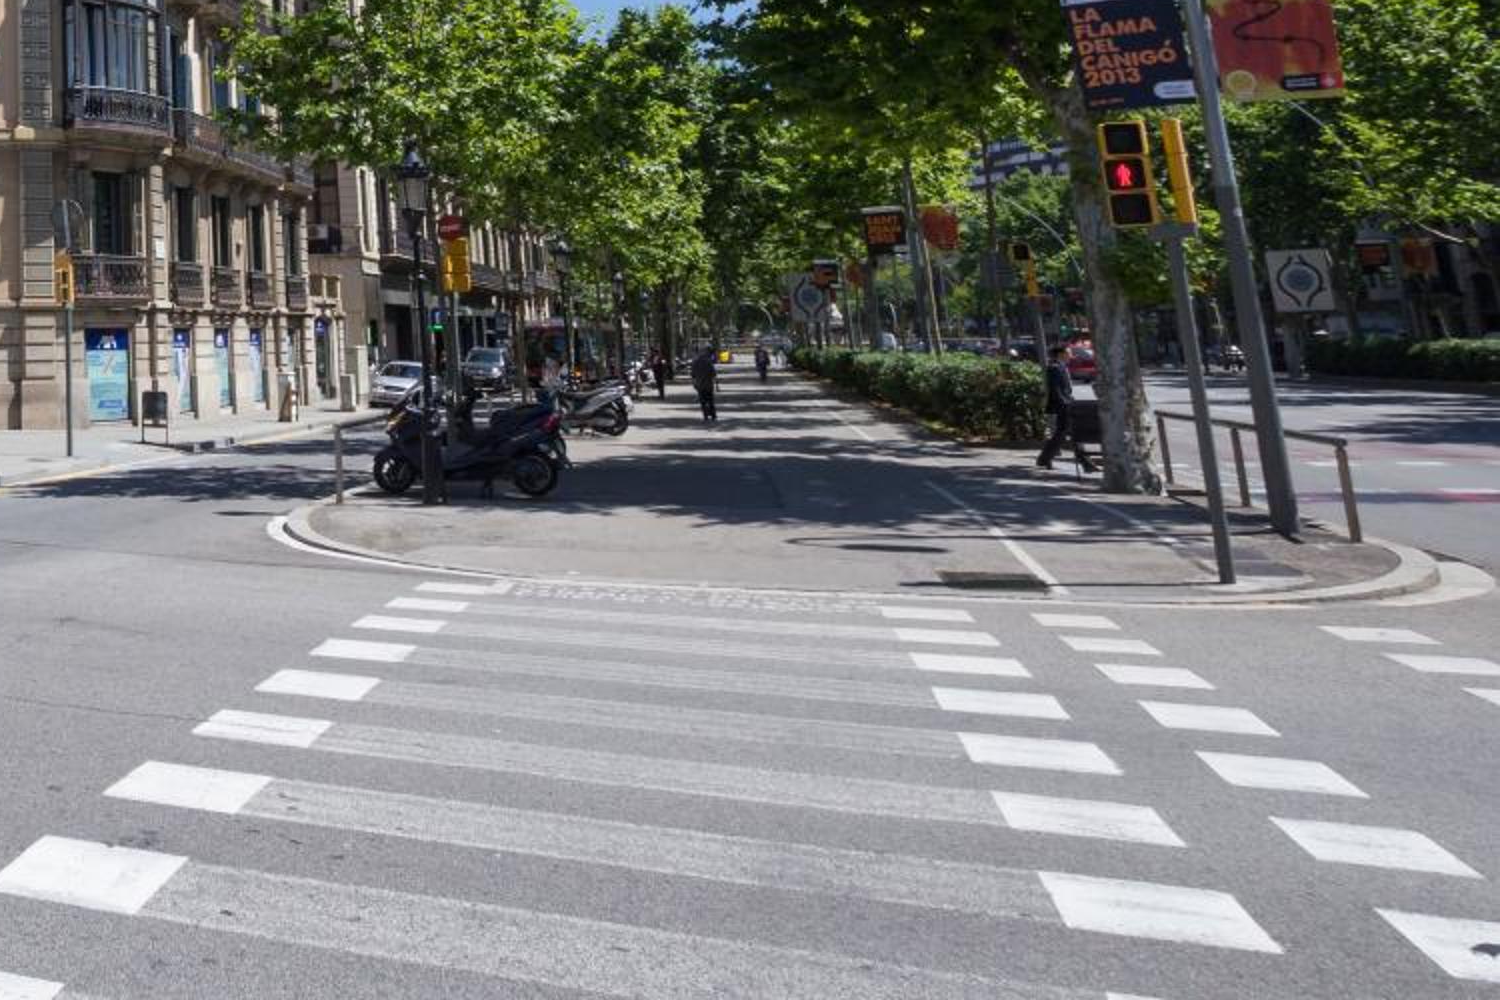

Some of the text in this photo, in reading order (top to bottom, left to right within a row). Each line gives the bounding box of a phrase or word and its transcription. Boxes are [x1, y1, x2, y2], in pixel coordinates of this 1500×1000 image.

[1070, 8, 1101, 24] LA
[1074, 18, 1156, 40] FLAMA
[1077, 39, 1119, 56] DEL
[1081, 40, 1177, 72] CANIGÓ
[1084, 67, 1142, 88] 2013
